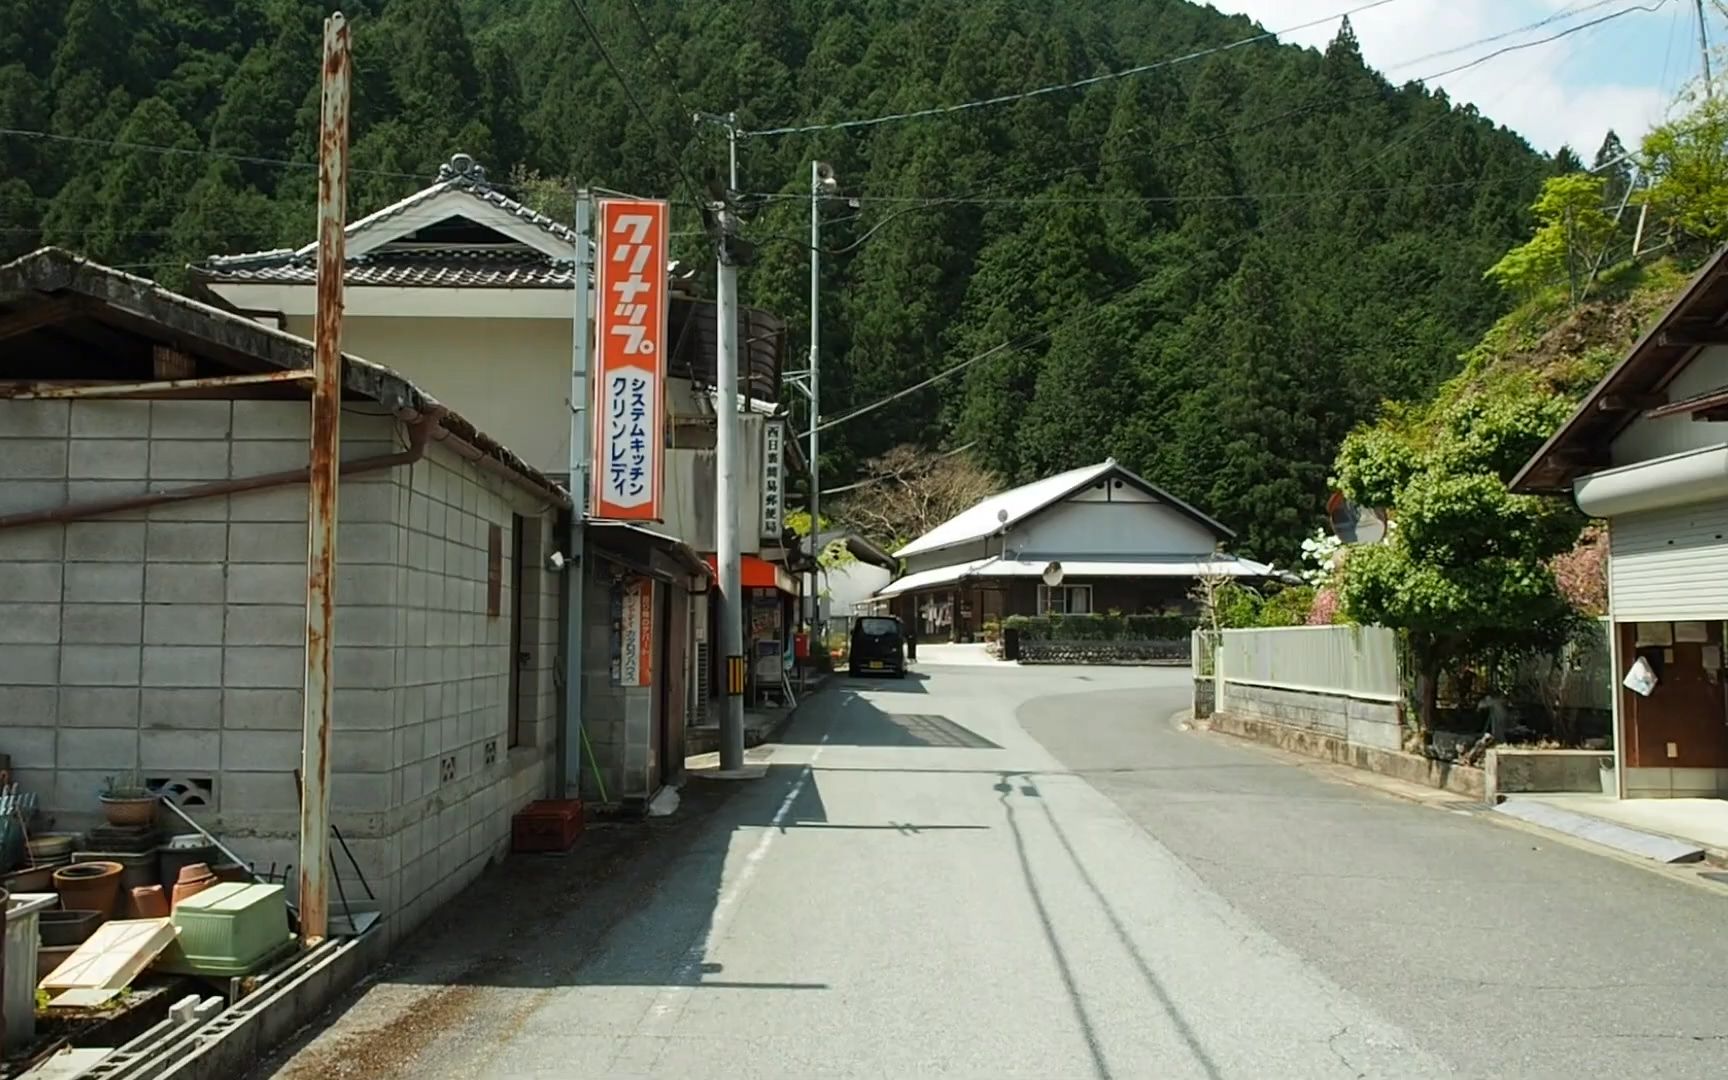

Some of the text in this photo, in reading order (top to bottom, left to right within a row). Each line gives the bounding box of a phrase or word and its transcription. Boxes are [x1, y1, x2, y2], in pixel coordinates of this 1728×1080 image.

[611, 214, 655, 355] クリナップ
[610, 377, 627, 496] クリンレディ
[629, 378, 646, 496] システムキッチン
